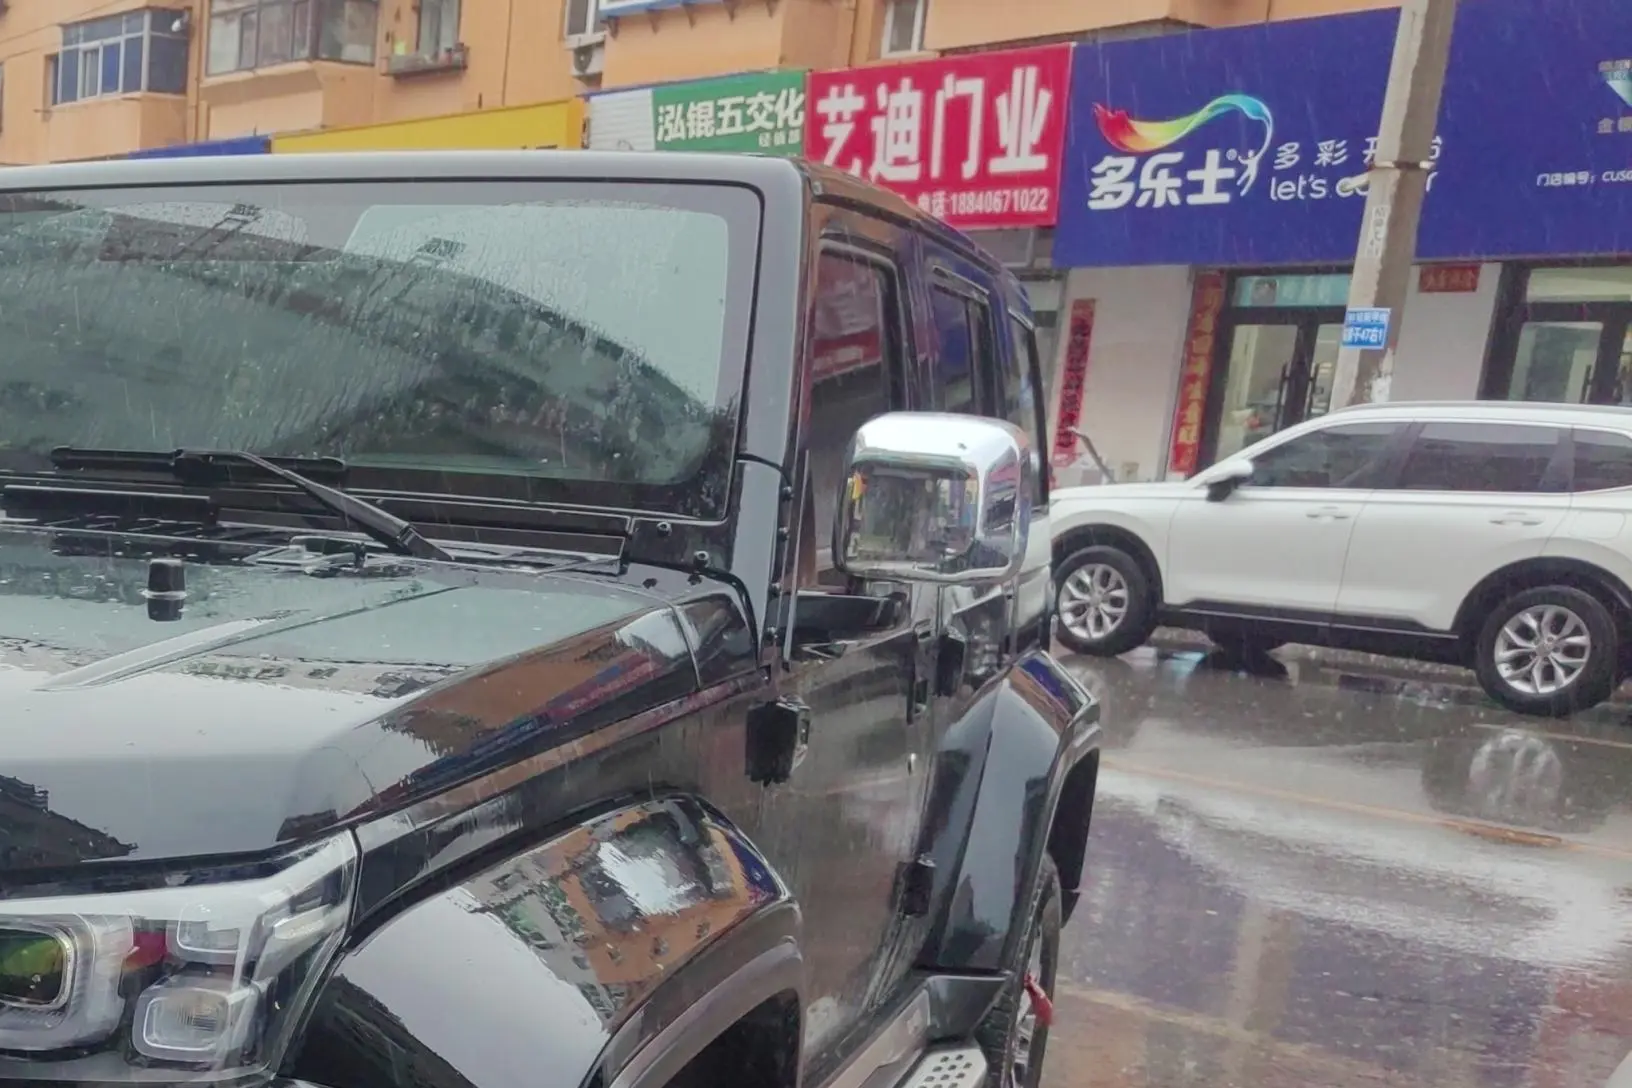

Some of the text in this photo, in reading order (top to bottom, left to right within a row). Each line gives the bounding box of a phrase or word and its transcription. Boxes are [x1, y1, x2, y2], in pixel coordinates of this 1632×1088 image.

[657, 87, 805, 142] 泓锟五交化
[817, 66, 1052, 182] 艺迪门业
[1087, 149, 1235, 210] 多乐士
[1270, 174, 1327, 201] let's
